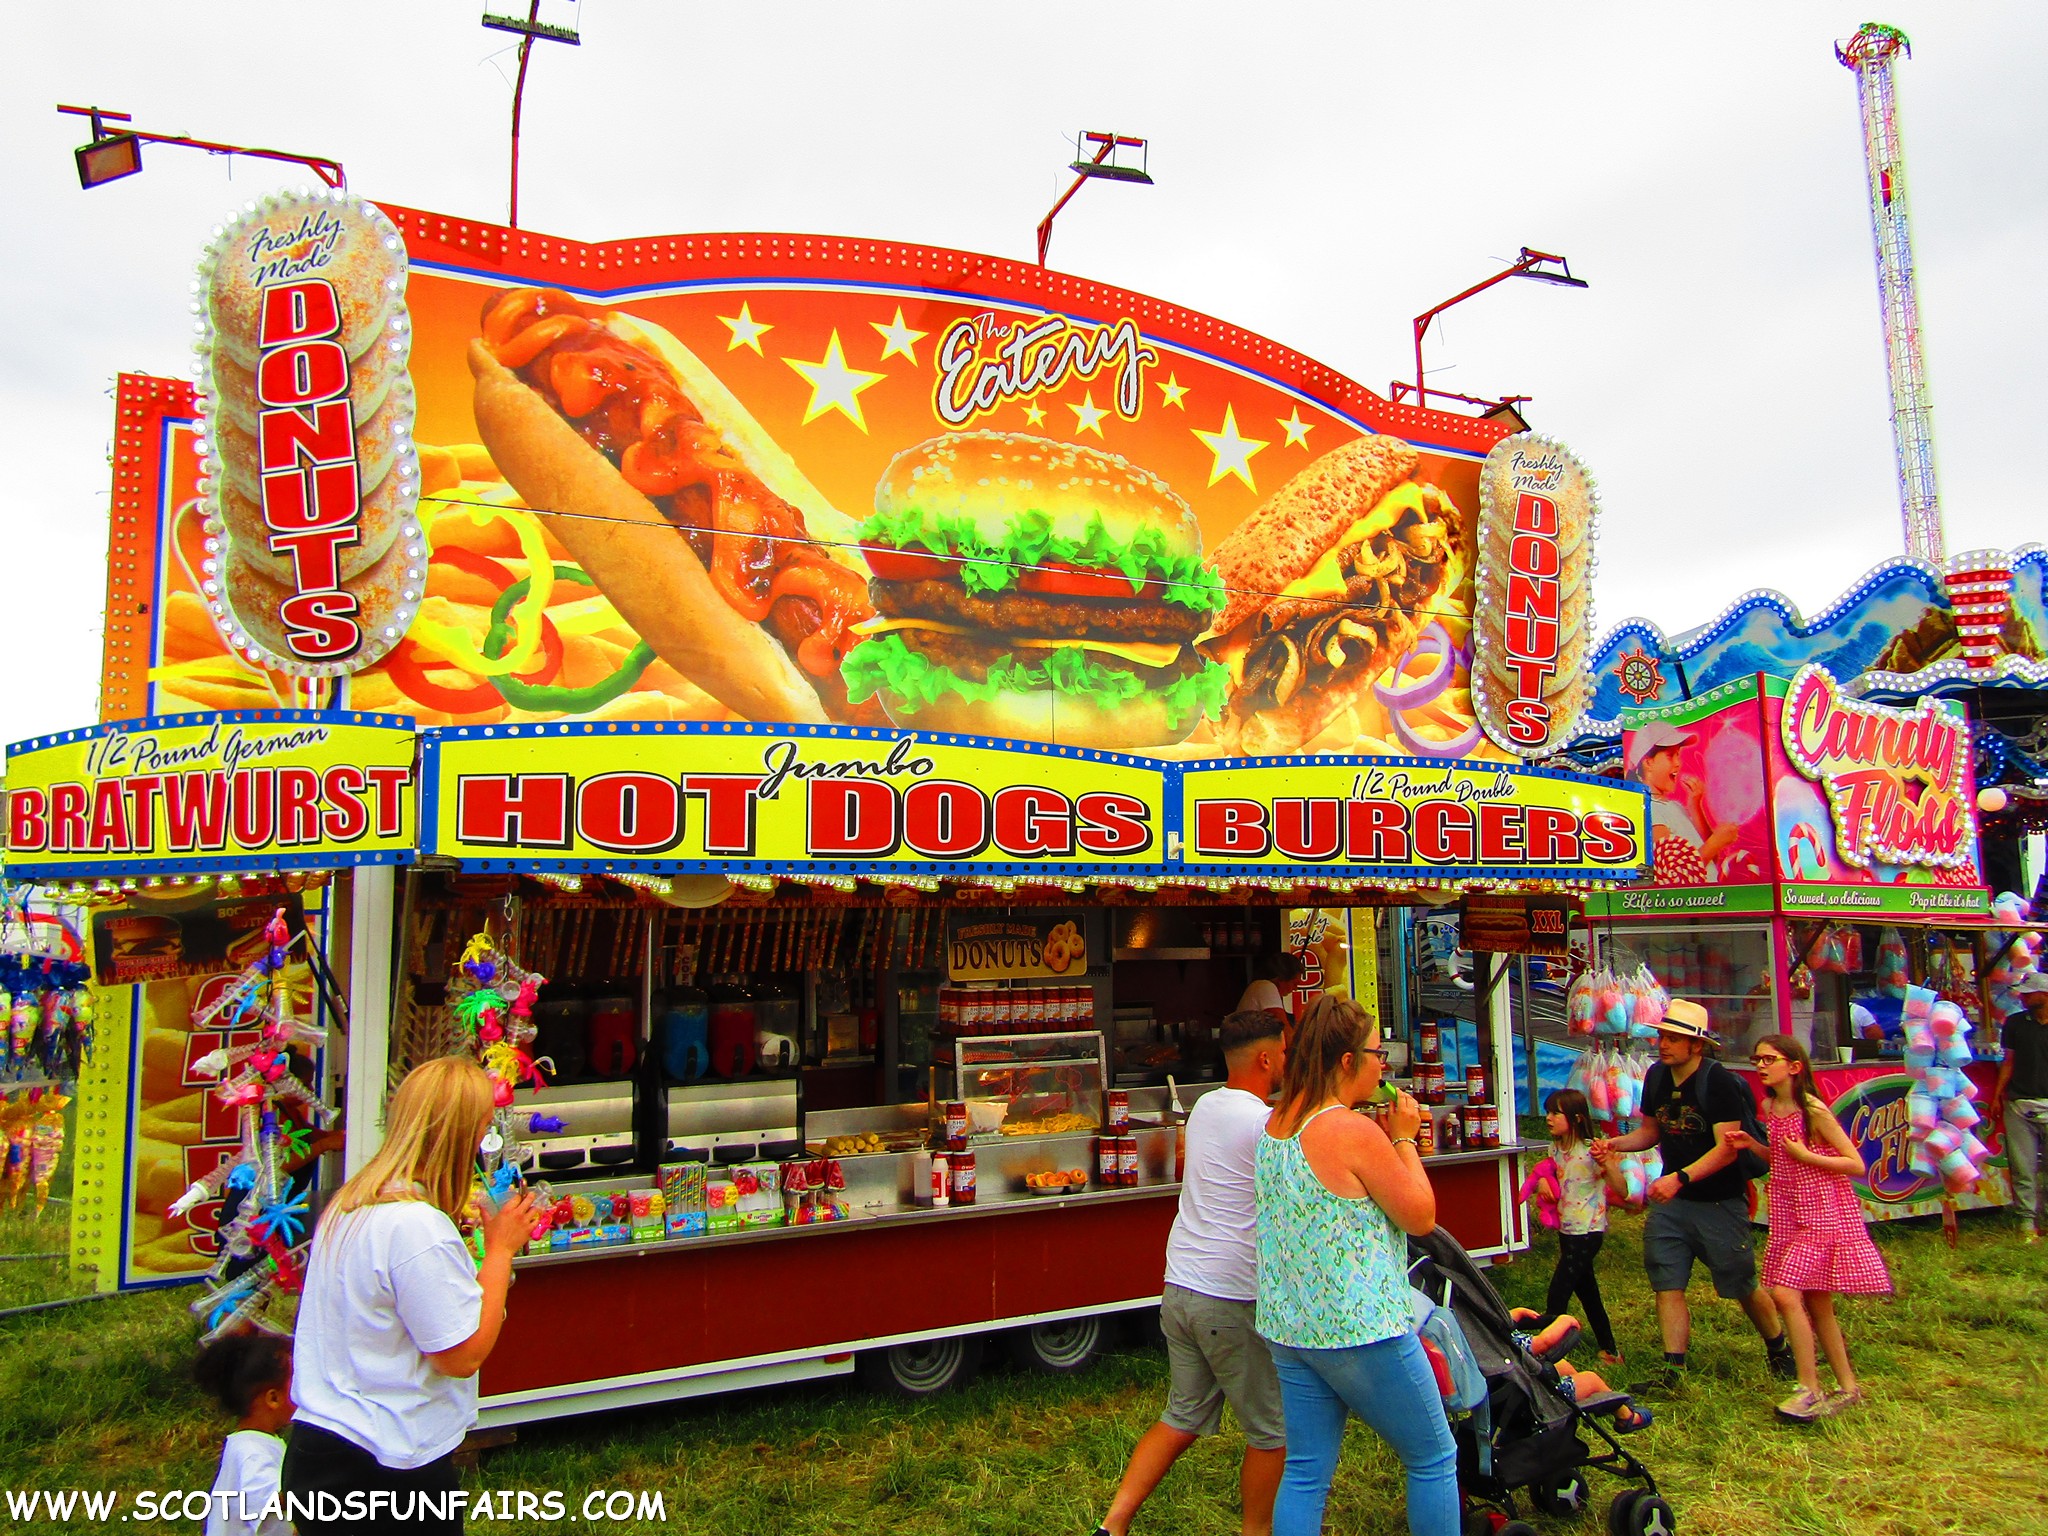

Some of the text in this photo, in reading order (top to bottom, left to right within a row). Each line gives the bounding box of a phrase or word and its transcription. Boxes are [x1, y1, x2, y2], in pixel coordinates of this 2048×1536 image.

[246, 210, 345, 259] Freshly
[250, 250, 333, 288] Made
[972, 312, 1011, 341] The
[938, 320, 1154, 423] Eatery
[257, 277, 362, 662] DONUTS
[1510, 451, 1564, 480] Freshly
[1511, 475, 1558, 491] Made
[1504, 490, 1561, 744] DONUTS
[85, 723, 329, 777] 1/2 Pound German
[1789, 674, 1957, 792] Candy
[758, 737, 934, 798] Jumbo
[1352, 768, 1515, 803] 1/2 Pound Double
[8, 765, 411, 855] BRATWURST
[456, 772, 1152, 856] HOT DOGS
[1832, 769, 1965, 855] Floss
[1194, 798, 1638, 866] BURGERS
[1622, 892, 1725, 911] Life is so sweet
[1784, 888, 1881, 906] So sweet, so delicious
[1909, 891, 1928, 910] Pop
[1930, 892, 1938, 905] it
[1938, 892, 1953, 906] like
[1966, 893, 1980, 908] hot
[957, 923, 1036, 940] FRESHLY MADE
[1532, 910, 1564, 934] XXL
[117, 963, 178, 977] BURGER
[953, 939, 1041, 970] DONUTS
[1851, 1096, 1910, 1150] Can
